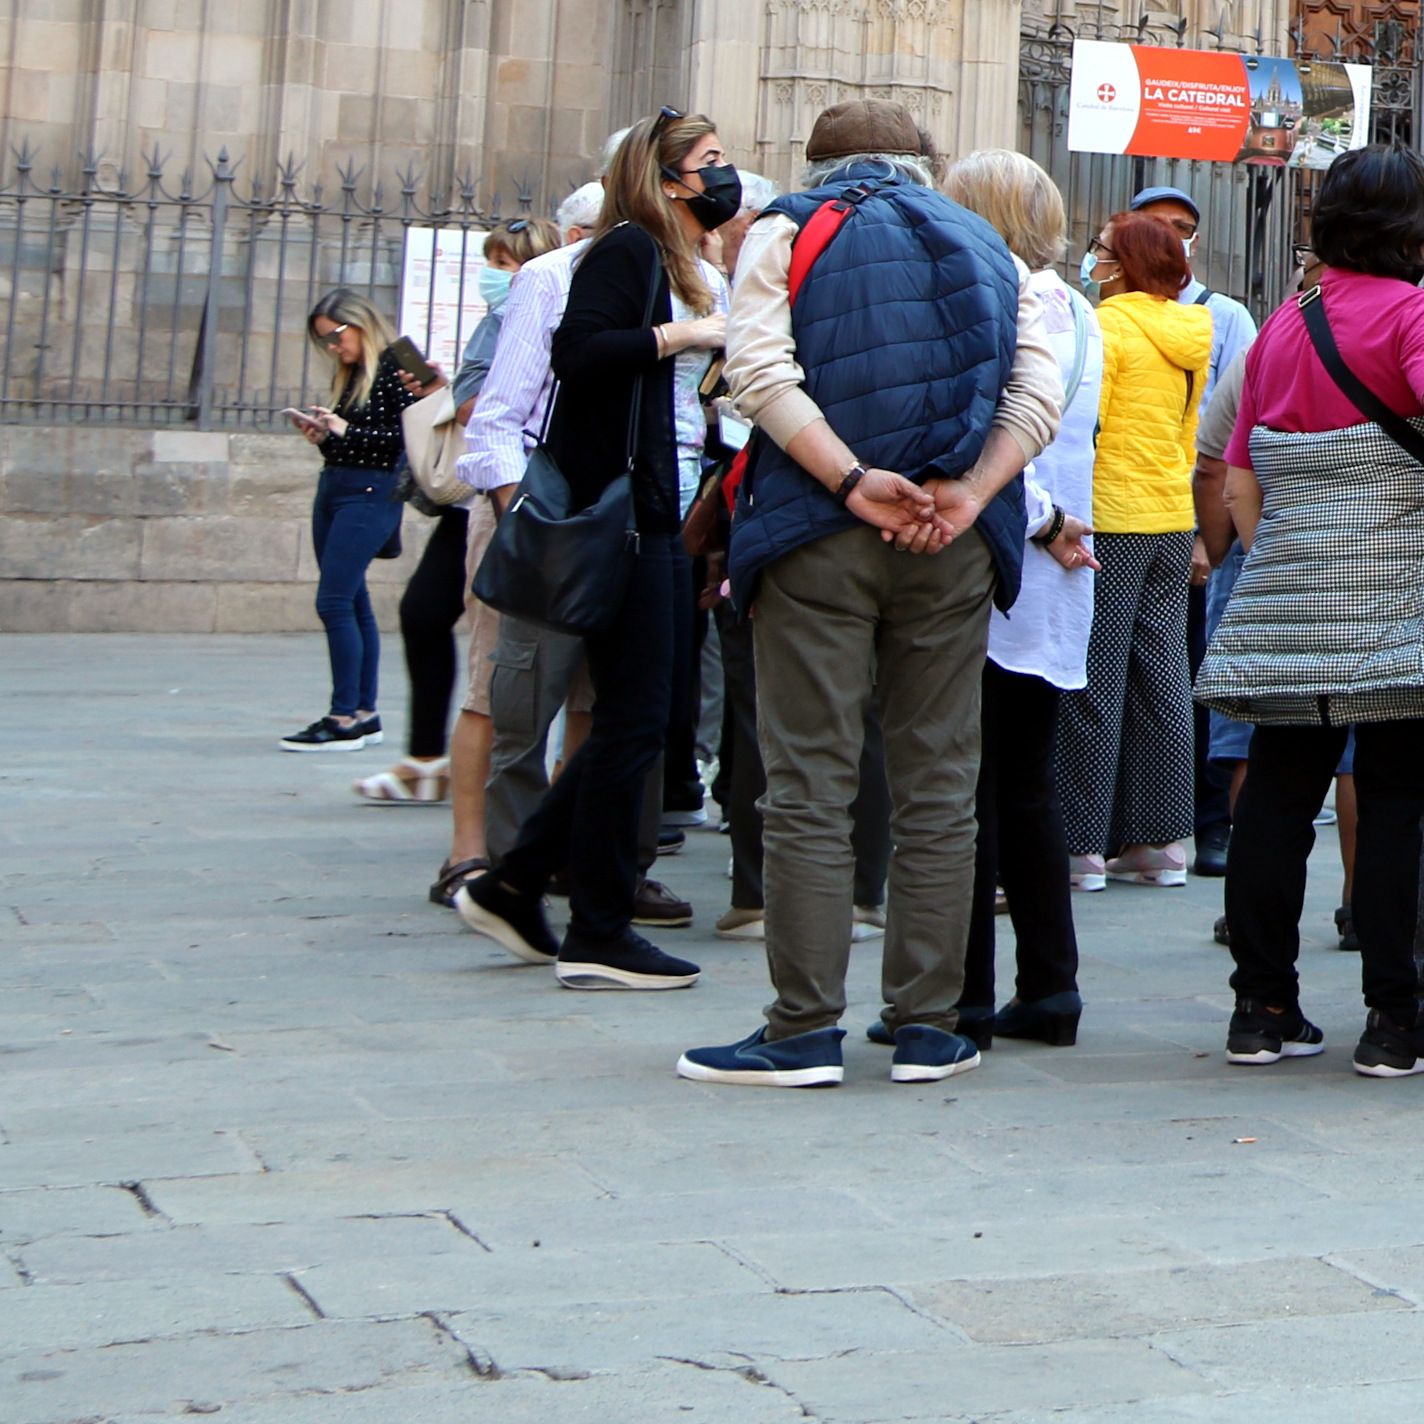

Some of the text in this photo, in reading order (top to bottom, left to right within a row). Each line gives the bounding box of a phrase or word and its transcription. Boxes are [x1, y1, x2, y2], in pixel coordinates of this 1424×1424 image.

[1145, 78, 1246, 93] GAUDEIX/DISFRUTA/ENJOY
[1144, 86, 1245, 107] LA CATEDRAL
